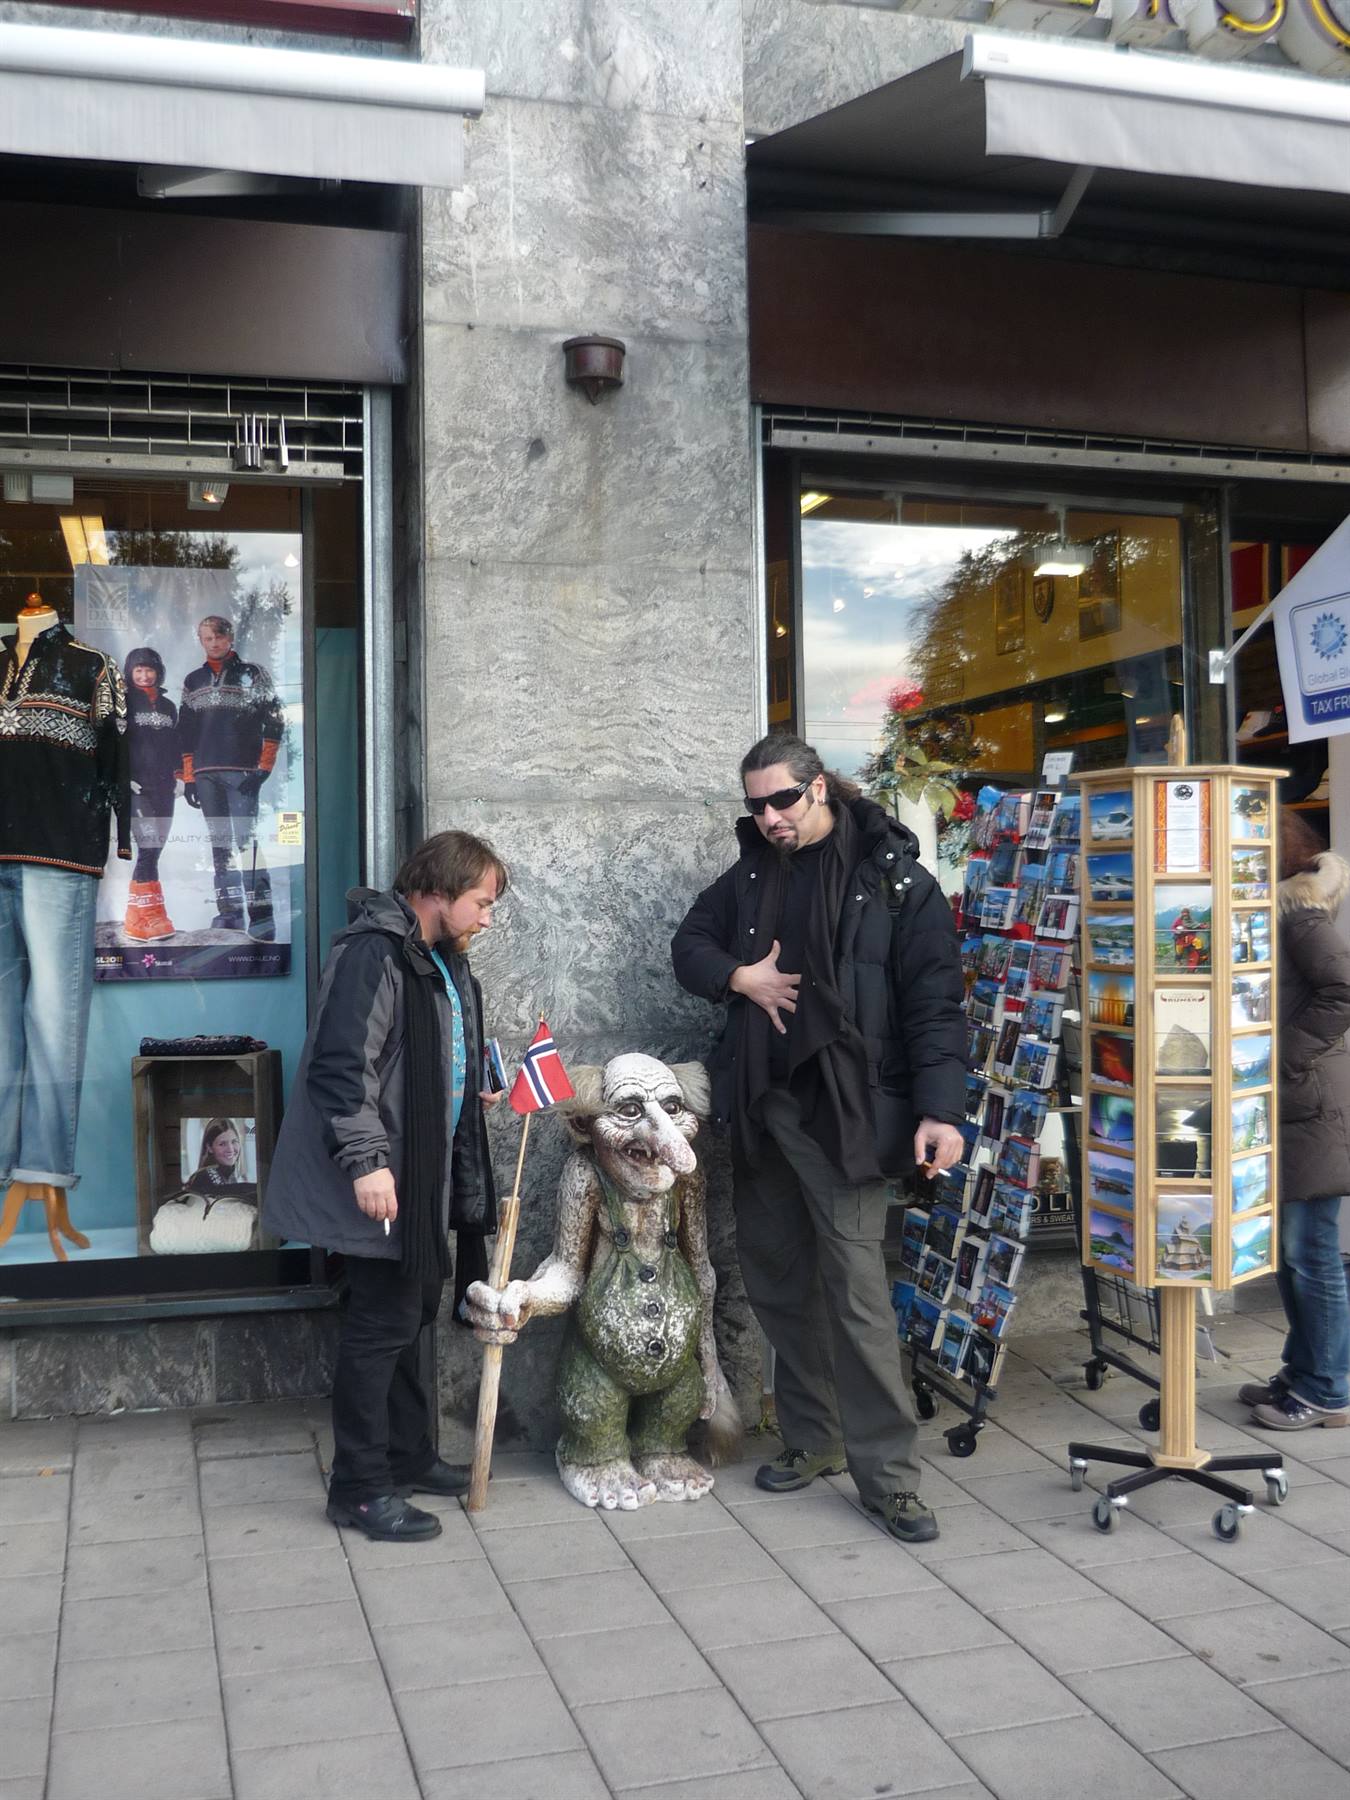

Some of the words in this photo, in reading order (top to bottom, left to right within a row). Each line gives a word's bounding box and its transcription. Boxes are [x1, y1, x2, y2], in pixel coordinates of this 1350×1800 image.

[1308, 670, 1337, 686] Global
[1339, 666, 1350, 679] Bl
[1311, 699, 1333, 715] TAX
